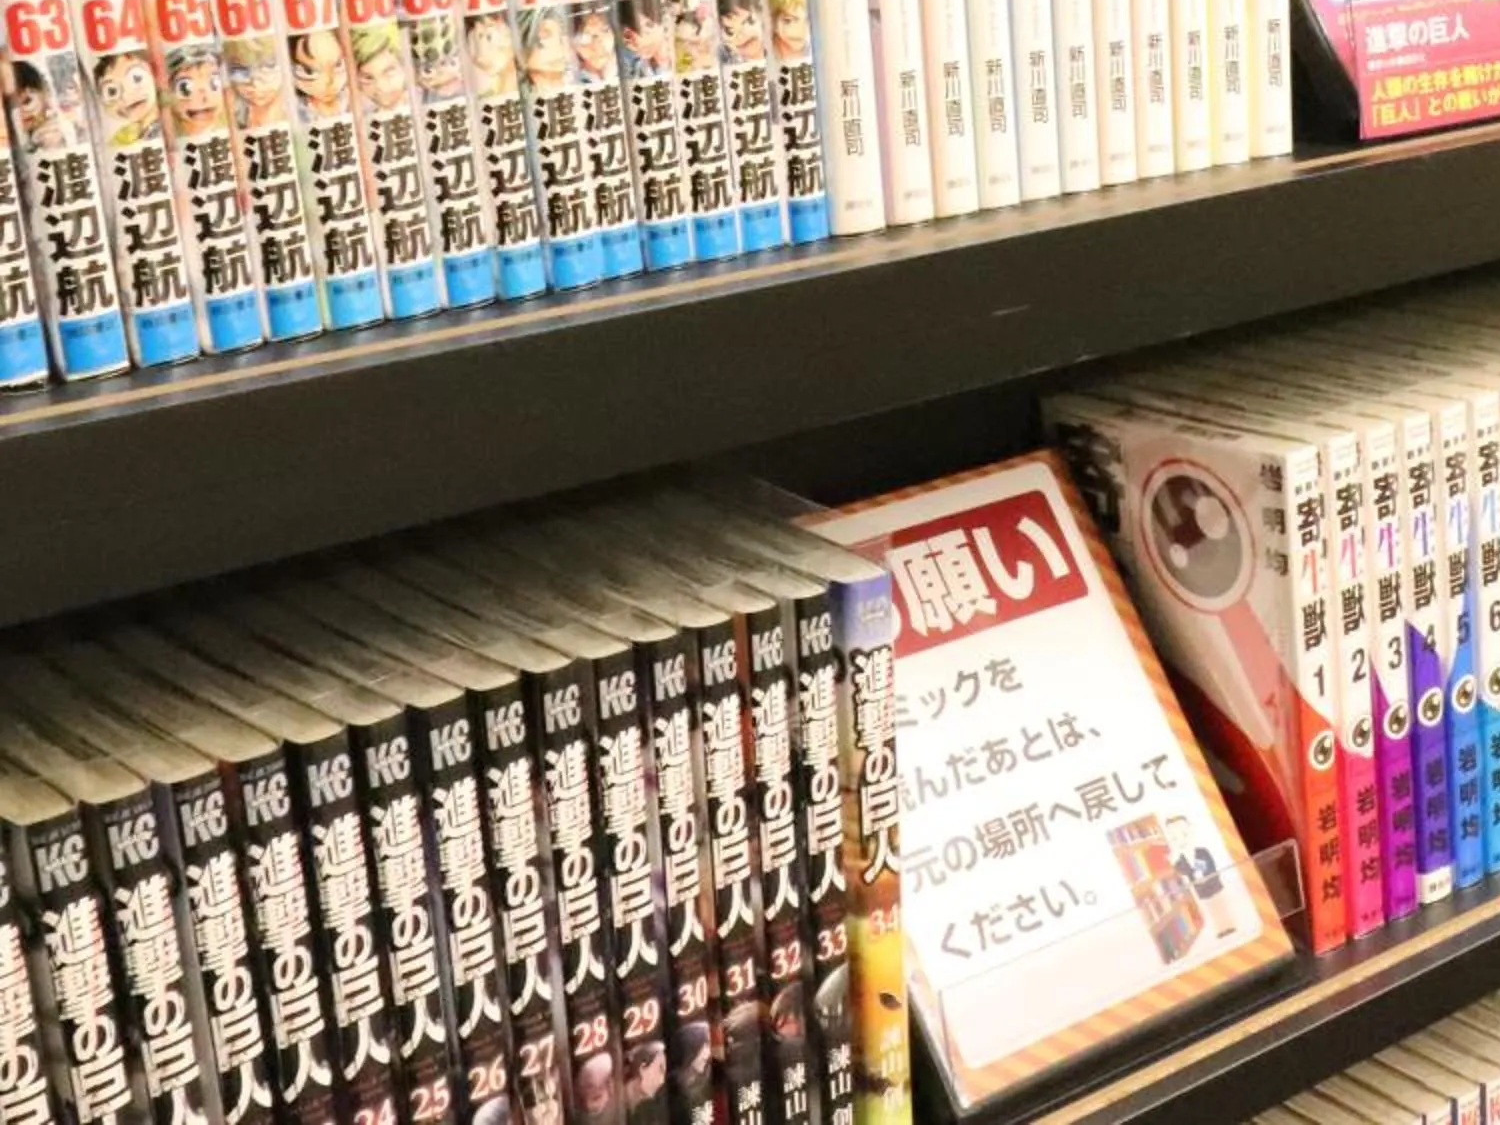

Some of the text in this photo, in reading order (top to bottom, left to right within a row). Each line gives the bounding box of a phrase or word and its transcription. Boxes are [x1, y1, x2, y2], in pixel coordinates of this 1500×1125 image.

[1366, 13, 1470, 55] 進撃の巨人
[309, 122, 373, 275] 渡辺航
[370, 115, 433, 265] 渡辺航
[427, 105, 486, 252] 渡辺航
[482, 99, 544, 245] 渡辺航
[535, 92, 593, 236] 渡辺航
[581, 85, 636, 229] 渡辺航
[633, 80, 686, 222] 渡辺航
[681, 75, 732, 212] 渡辺航
[730, 68, 780, 203] 渡辺航
[781, 66, 824, 200] 渡辺航
[37, 152, 114, 315] 渡辺航
[114, 147, 186, 308] 渡辺航
[185, 136, 257, 294] 渡辺航
[244, 128, 311, 285] 渡辺航
[889, 517, 1070, 637] 願い
[1422, 624, 1436, 652] 4
[1457, 613, 1471, 644] 5
[1314, 665, 1324, 696] 1
[1352, 648, 1366, 682] 2
[1388, 636, 1402, 669] 3
[654, 708, 704, 956] 進撃の巨人
[703, 693, 755, 938] 進撃の巨人
[752, 680, 799, 921] 進撃の巨人
[800, 665, 846, 903] 進撃の巨人
[855, 649, 901, 884] 進撃の巨人
[903, 754, 1177, 892] 元の場所へ戻して
[433, 777, 501, 1038] 進撃の巨人
[488, 757, 552, 1015] 進撃の巨人
[545, 739, 605, 995] 進撃の巨人
[601, 726, 657, 979] 進撃の巨人
[869, 908, 899, 938] 34
[941, 879, 1097, 959] ください。
[186, 850, 272, 1125] 進撃の巨人
[248, 832, 332, 1103] 進撃の巨人
[312, 812, 390, 1081] 進撃の巨人
[370, 794, 445, 1058] 進撃の巨人
[678, 975, 707, 1017] 30
[727, 958, 755, 995] 31
[770, 942, 800, 979] 32
[817, 924, 847, 961] 33
[468, 1055, 506, 1100] 26
[519, 1036, 554, 1077] 27
[575, 1016, 608, 1054] 28
[623, 997, 661, 1038] 29
[410, 1077, 449, 1121] 25
